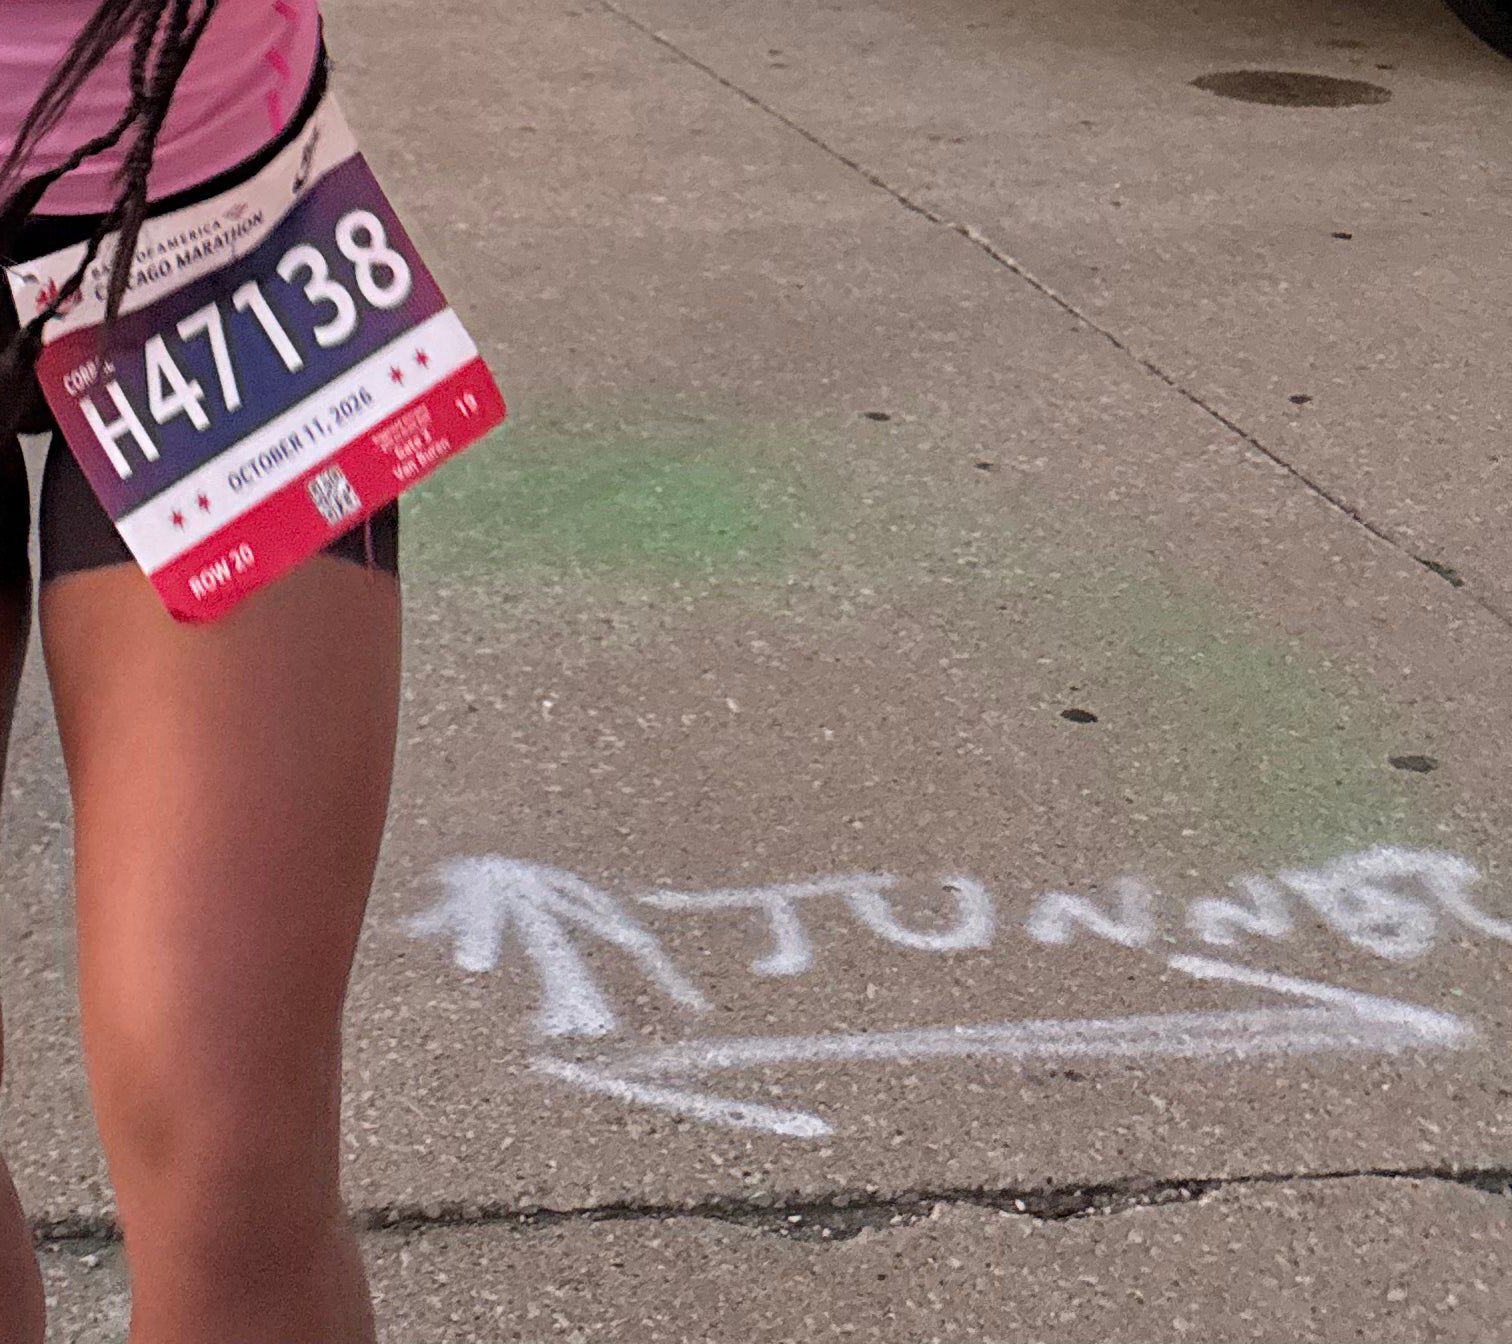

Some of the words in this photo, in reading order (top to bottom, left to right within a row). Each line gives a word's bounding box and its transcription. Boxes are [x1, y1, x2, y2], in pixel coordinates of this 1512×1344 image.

[156, 219, 222, 254] AMERICA
[175, 209, 265, 271] MARATHON
[79, 209, 413, 481] H47138
[227, 430, 304, 492] OCTOBER
[302, 415, 334, 444] 11,
[330, 386, 374, 425] 2026
[188, 556, 232, 602] ROW
[228, 542, 255, 574] 20
